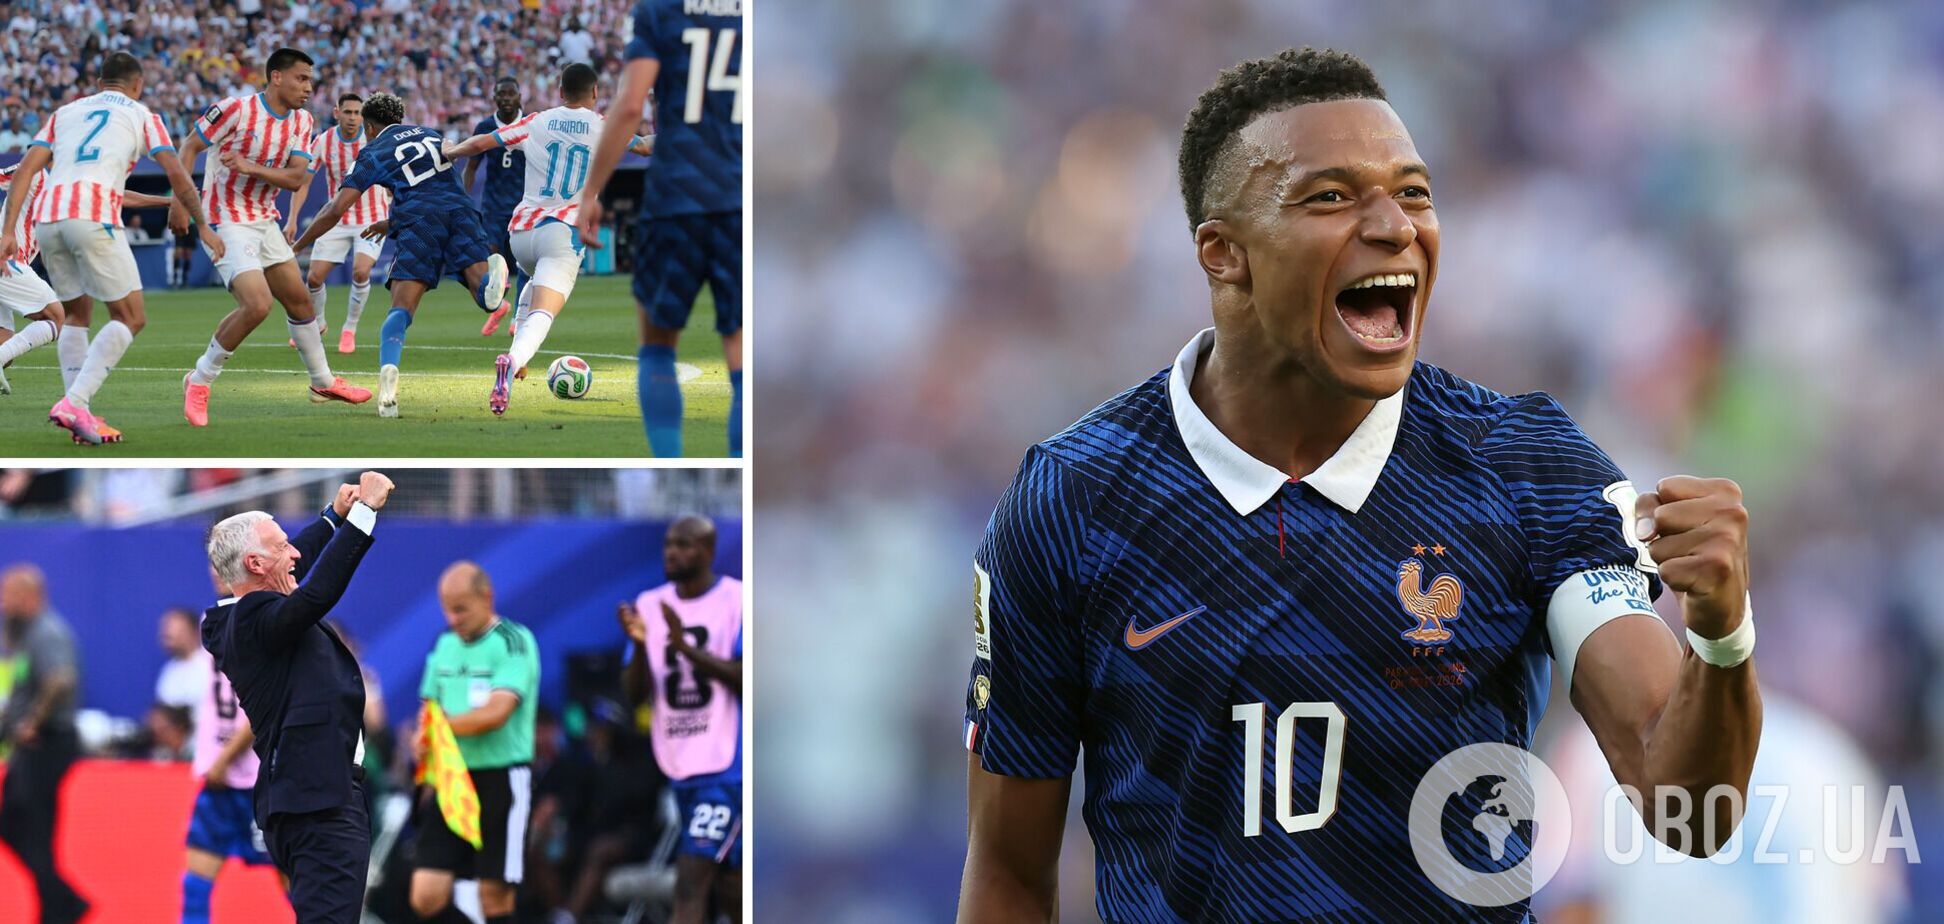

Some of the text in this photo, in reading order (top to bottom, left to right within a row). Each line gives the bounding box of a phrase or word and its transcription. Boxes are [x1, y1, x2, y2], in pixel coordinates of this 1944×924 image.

[682, 27, 743, 124] 14
[75, 109, 111, 163] 2
[502, 152, 512, 168] 6
[540, 140, 591, 200] 10
[1586, 586, 1623, 604] the
[1232, 702, 1348, 837] 10
[689, 803, 731, 839] 22
